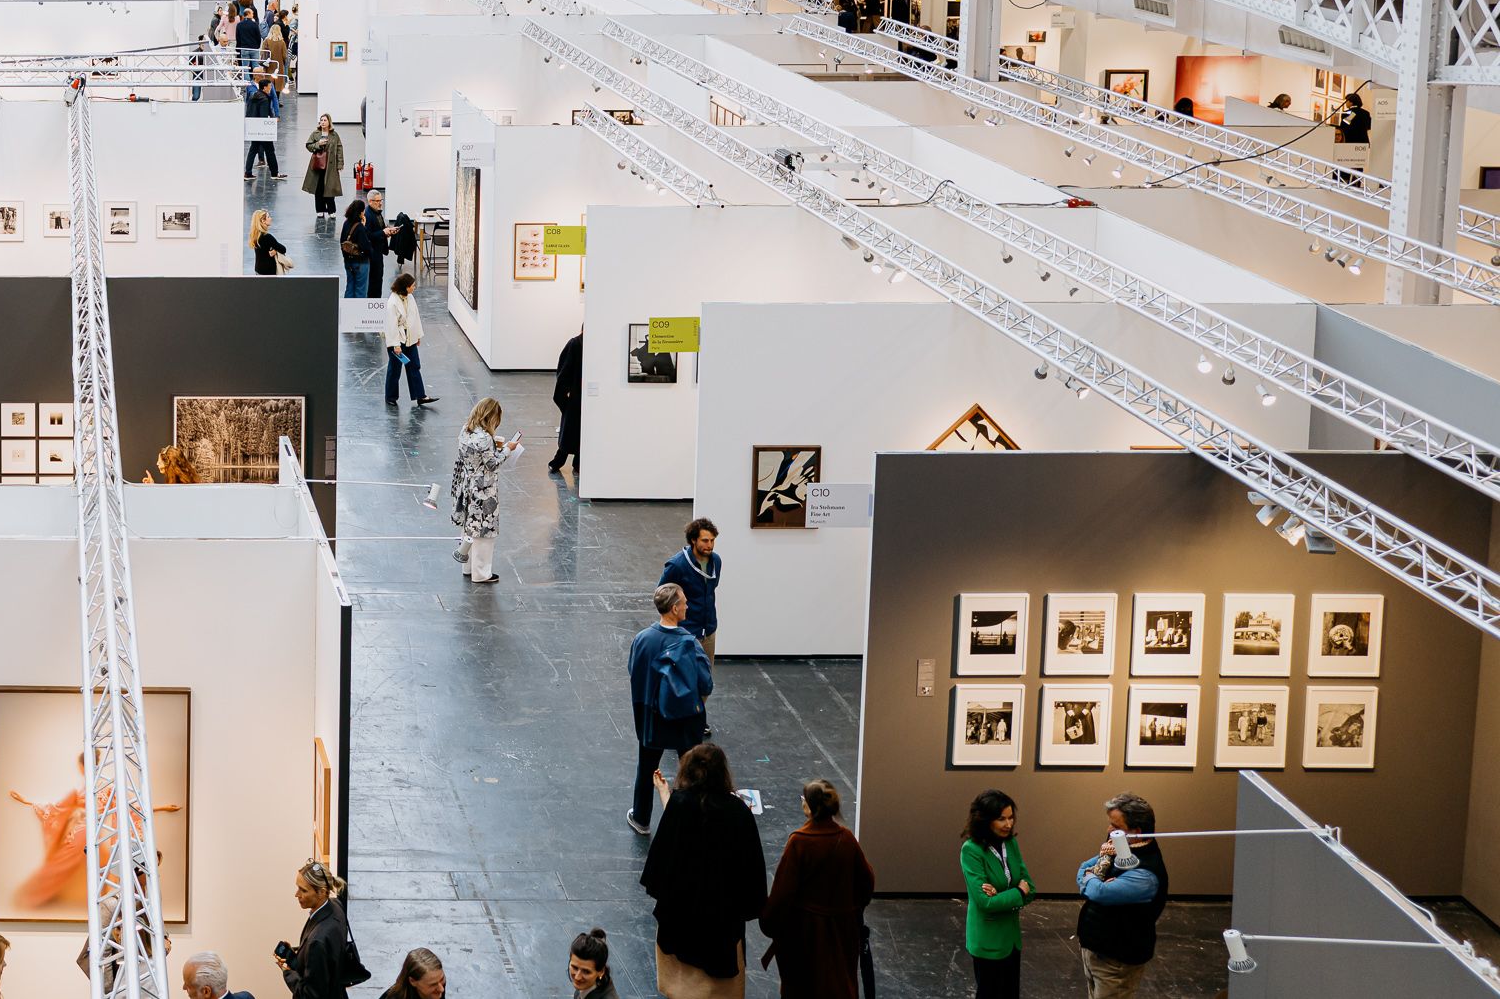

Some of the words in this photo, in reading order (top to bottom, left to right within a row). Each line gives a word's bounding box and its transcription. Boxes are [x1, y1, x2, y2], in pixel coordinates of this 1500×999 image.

[367, 302, 385, 310] D06
[652, 320, 670, 329] C09
[811, 487, 830, 498] C10
